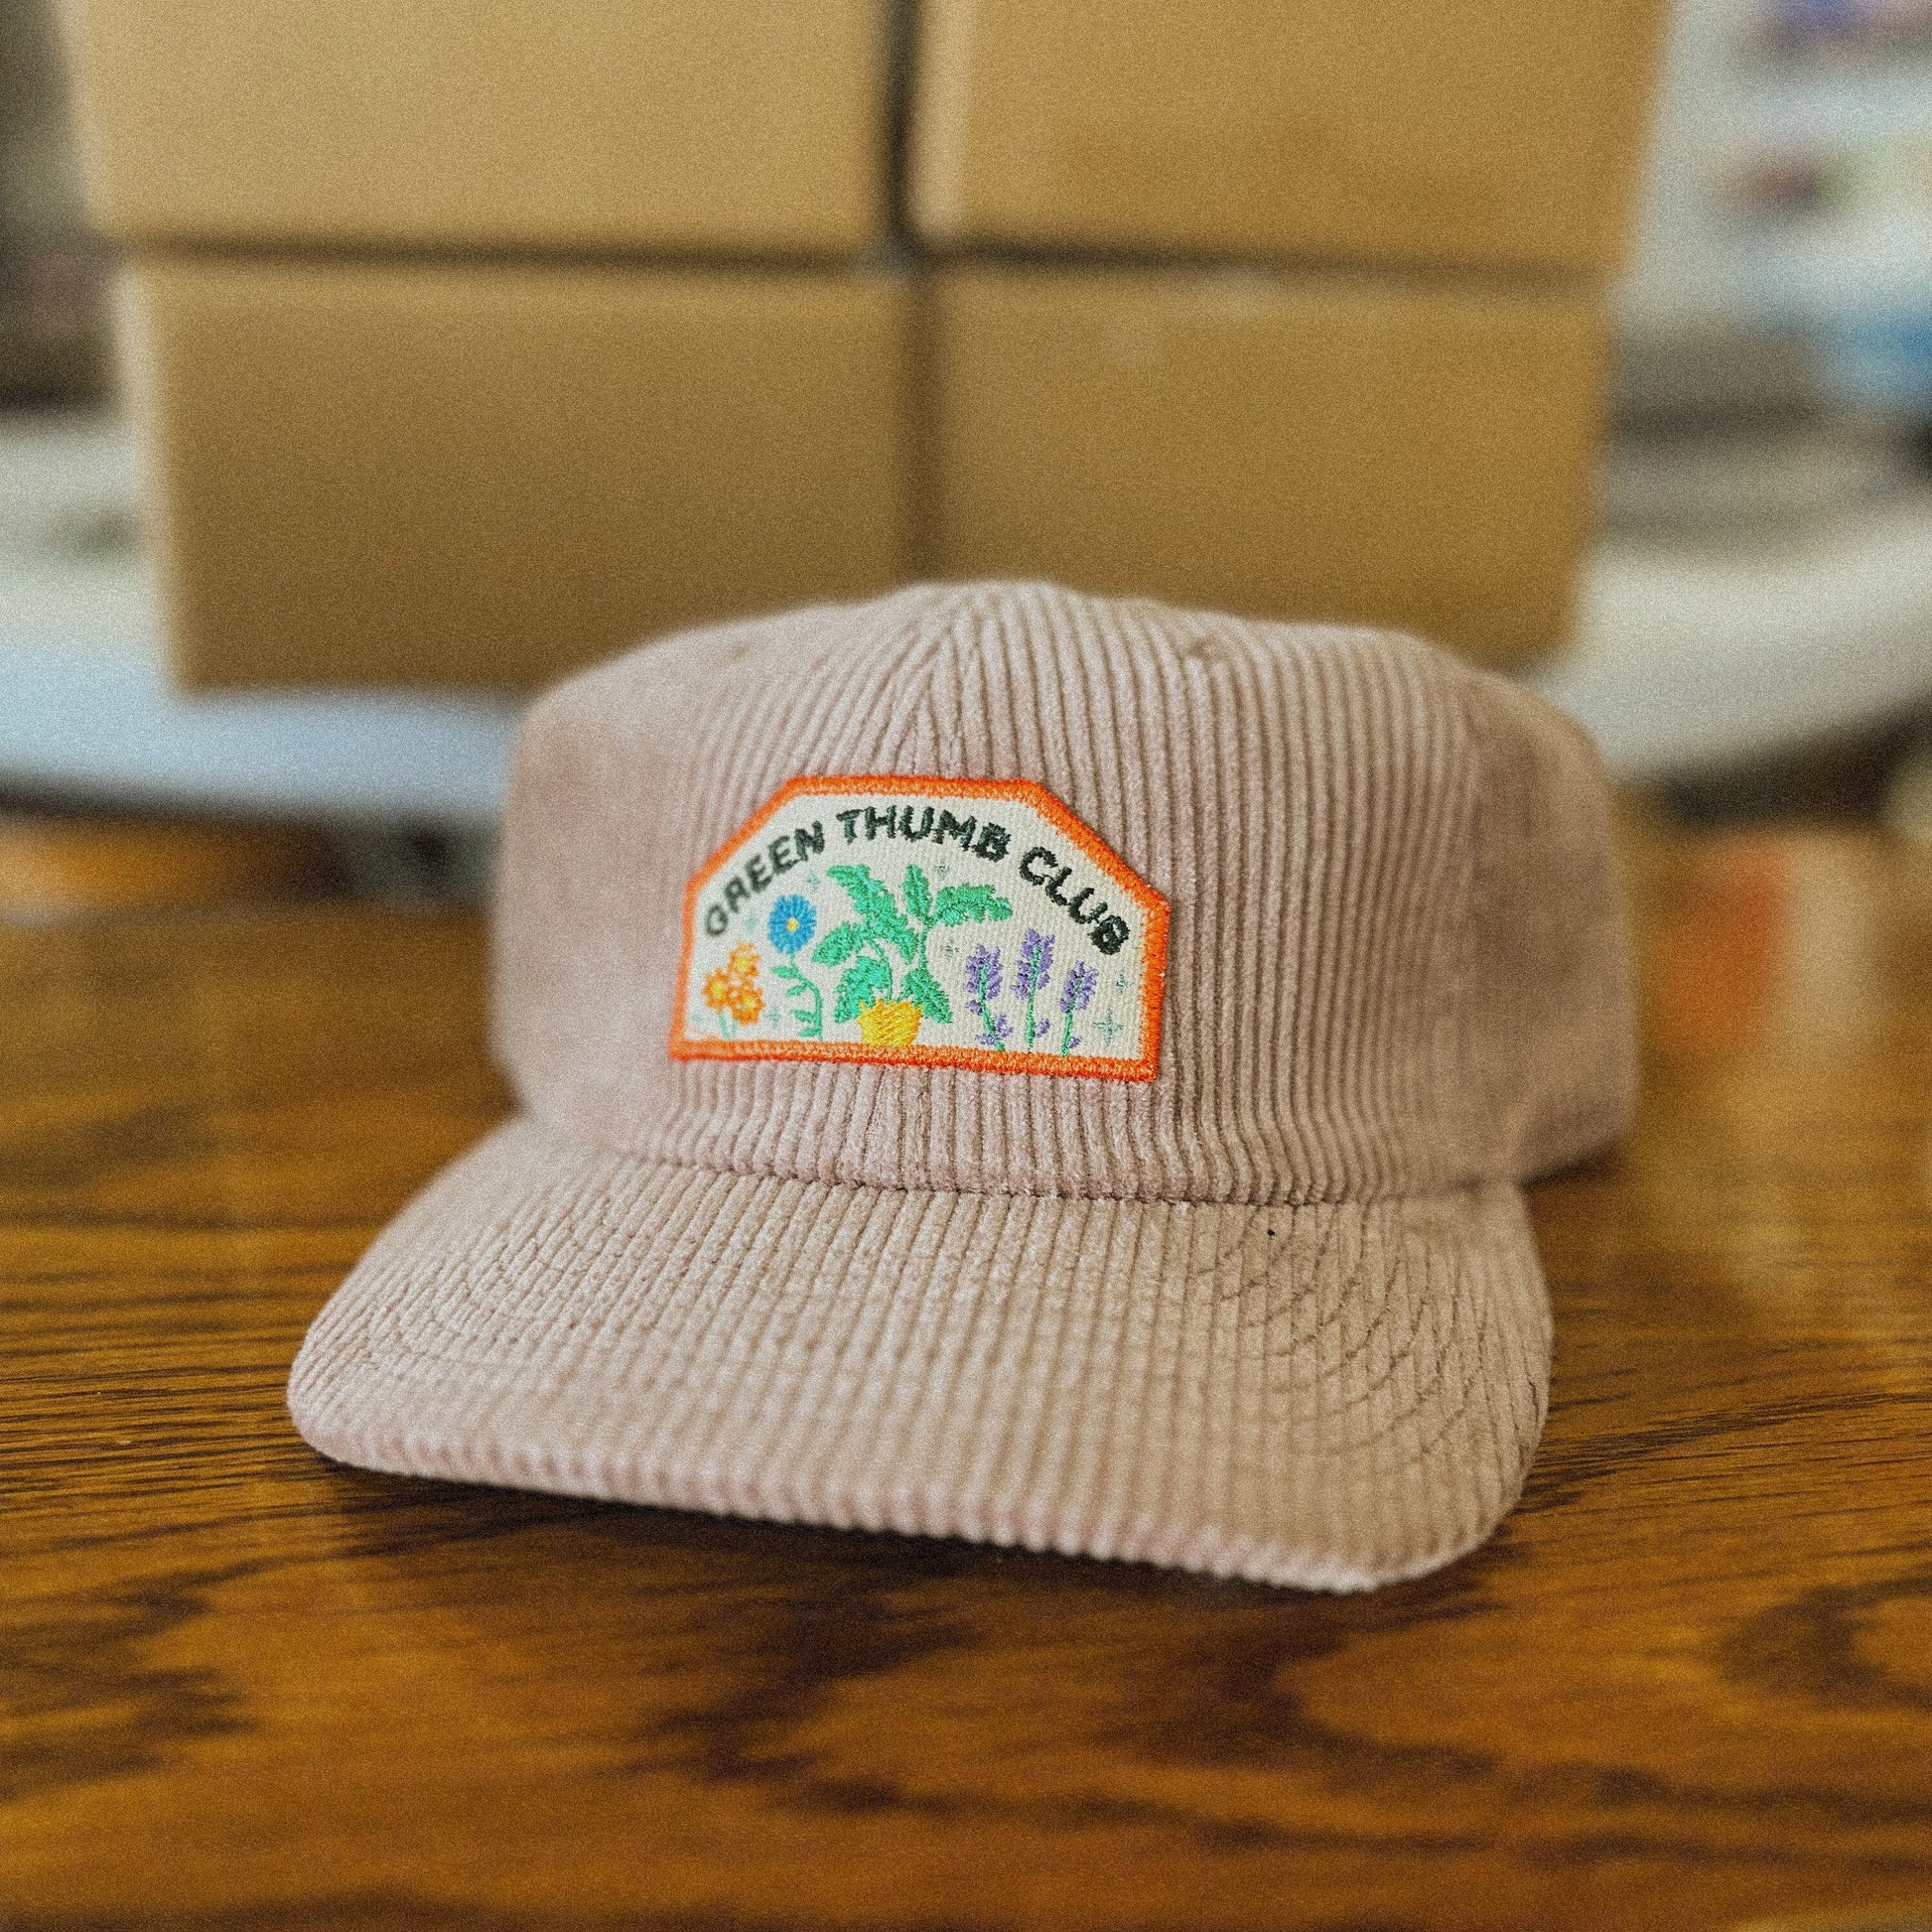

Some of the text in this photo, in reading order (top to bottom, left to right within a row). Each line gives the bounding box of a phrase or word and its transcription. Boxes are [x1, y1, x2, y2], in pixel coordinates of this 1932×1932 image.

[705, 805, 1130, 956] GREEN THUMB CLUB
